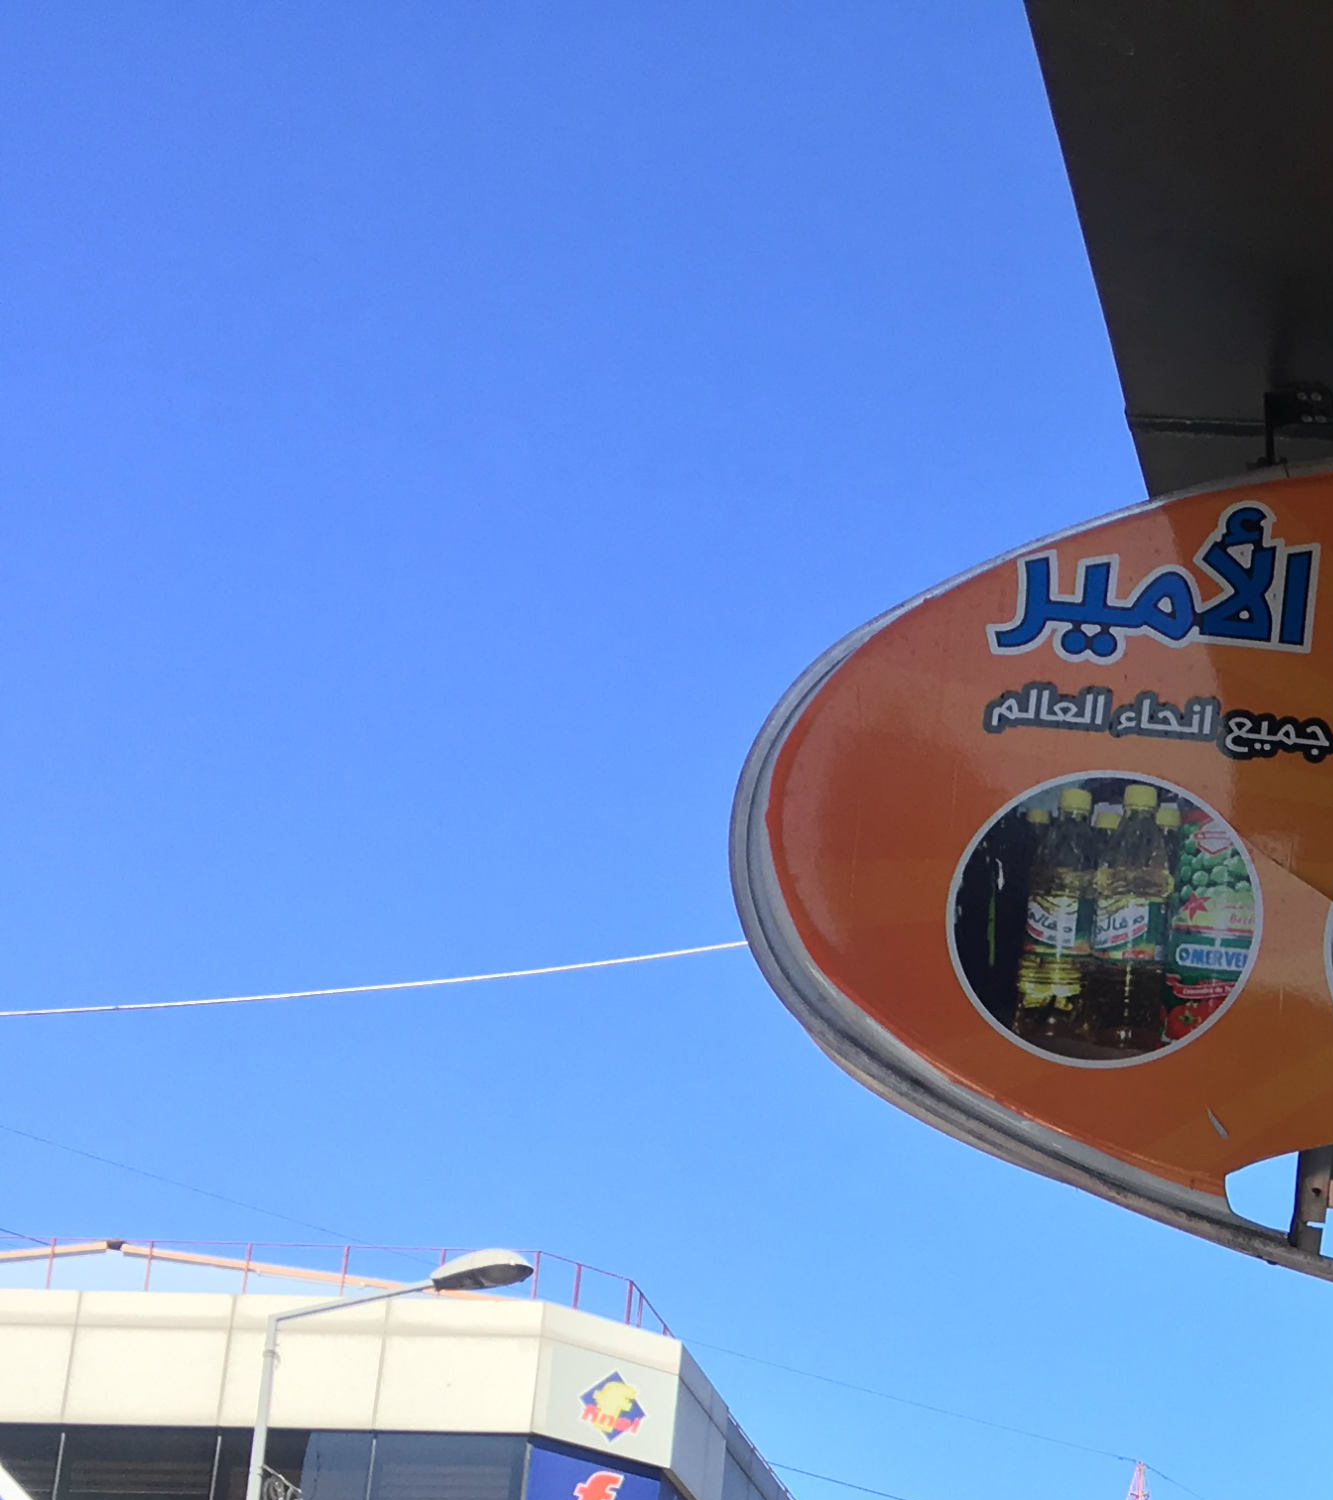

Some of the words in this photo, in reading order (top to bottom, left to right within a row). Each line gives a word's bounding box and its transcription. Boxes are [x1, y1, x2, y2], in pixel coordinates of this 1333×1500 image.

[988, 503, 1320, 663] الأمير
[991, 688, 1105, 728] العالم
[1117, 704, 1213, 736] انحاء
[1227, 716, 1331, 757] جميع
